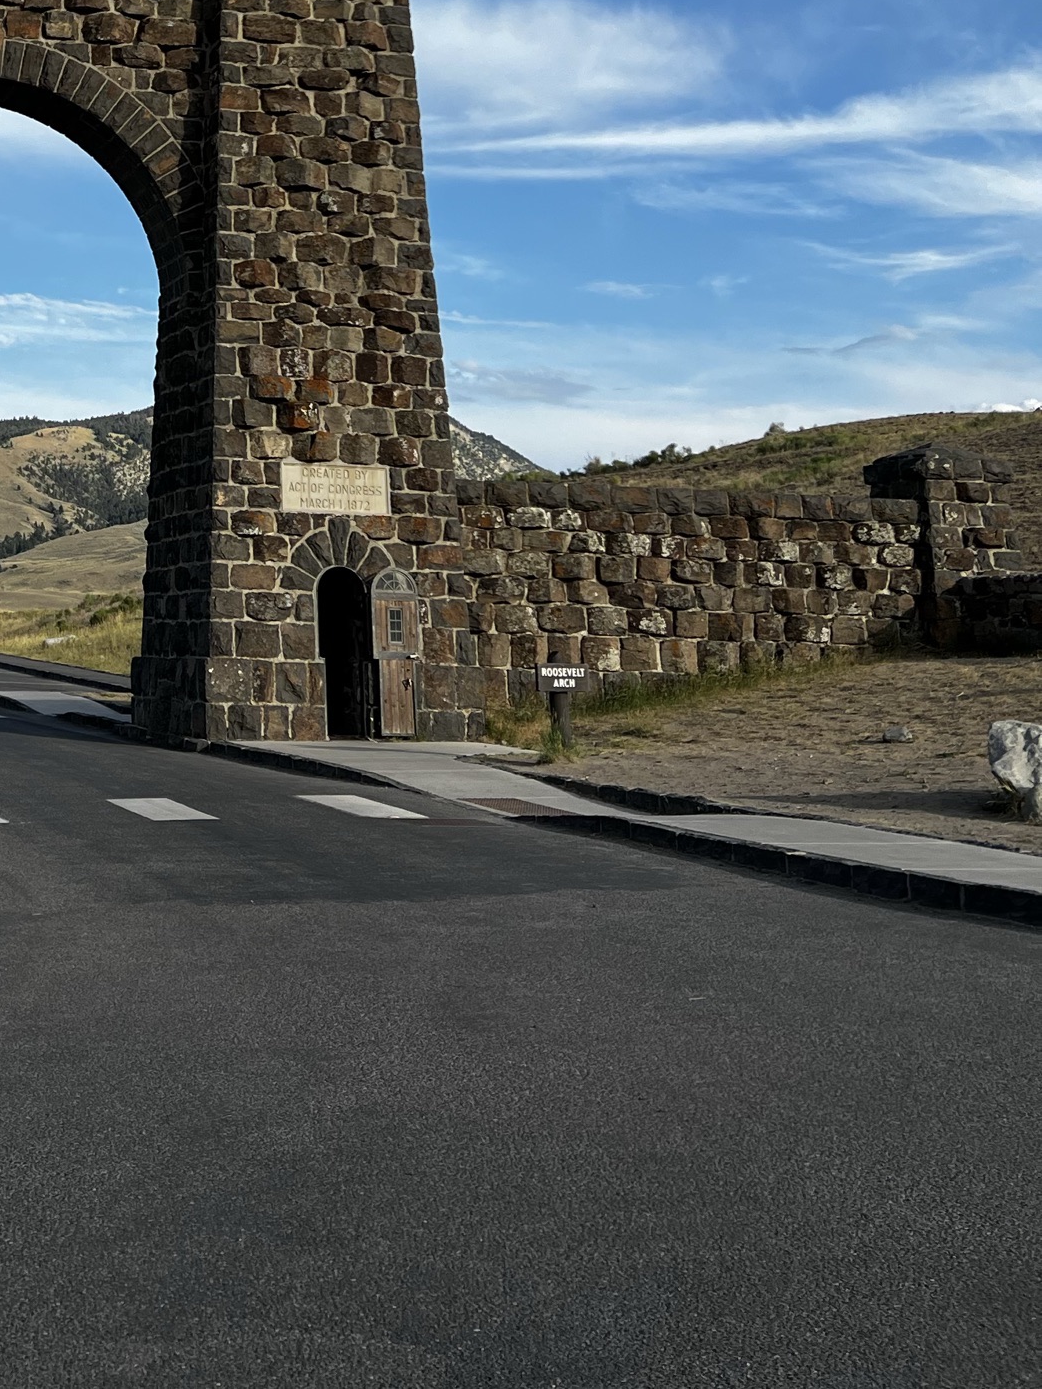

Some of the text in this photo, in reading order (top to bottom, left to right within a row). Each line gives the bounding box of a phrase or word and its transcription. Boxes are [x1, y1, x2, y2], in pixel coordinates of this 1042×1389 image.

[301, 467, 368, 480] CREATED BY
[288, 481, 383, 496] ACT OF CONGRESS
[300, 497, 336, 509] MARCH
[541, 667, 585, 677] ROOSEVELT
[553, 678, 576, 688] ARCH
